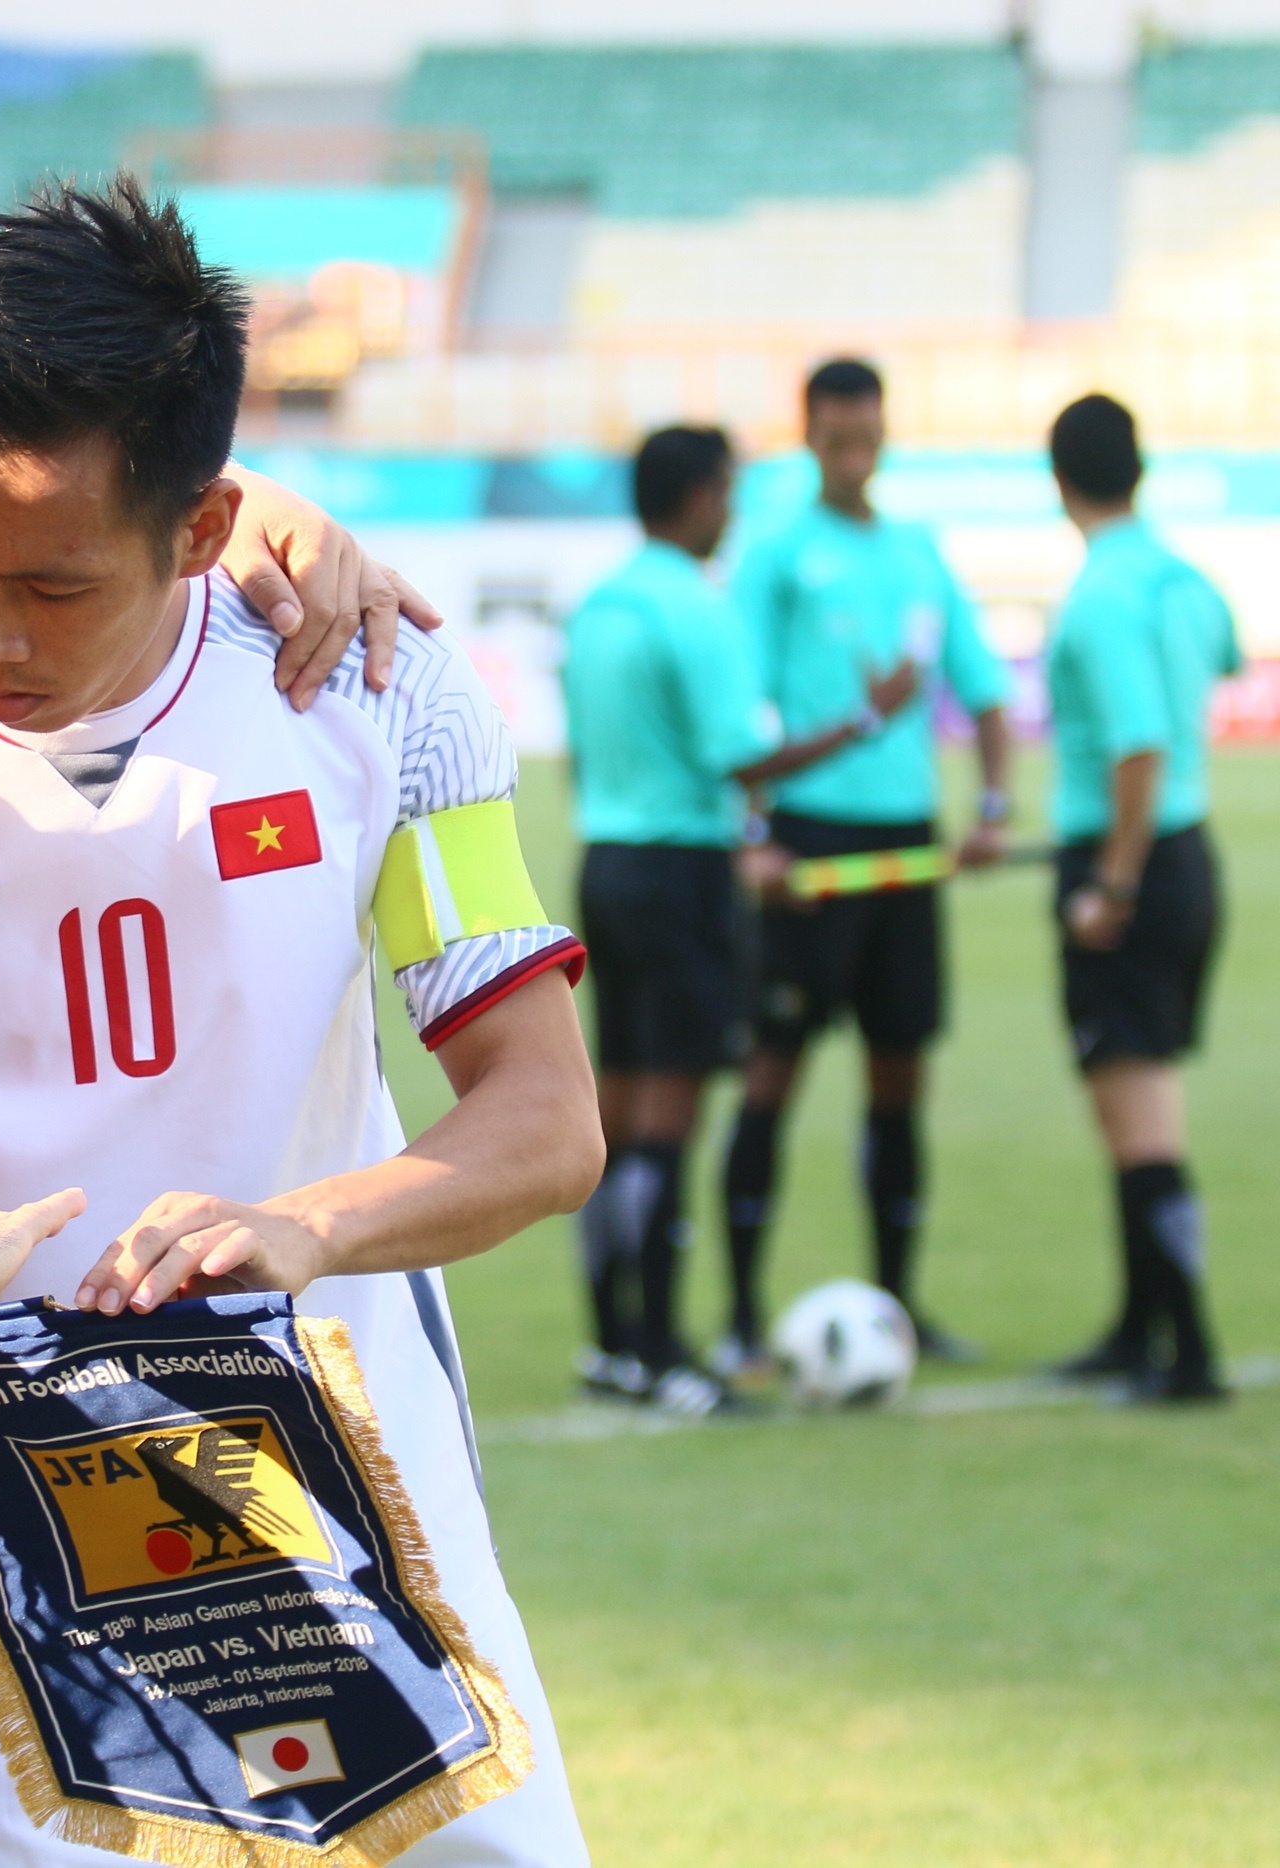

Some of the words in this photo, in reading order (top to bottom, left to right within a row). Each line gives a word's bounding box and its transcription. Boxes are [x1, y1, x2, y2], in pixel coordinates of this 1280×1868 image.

[58, 897, 177, 1085] 10
[7, 1356, 132, 1401] Football
[136, 1348, 288, 1380] Association
[44, 1448, 144, 1486] JFA
[62, 1629, 101, 1647] The
[144, 1613, 195, 1634] Asian
[195, 1601, 262, 1623] Games
[117, 1645, 206, 1678] Japan
[210, 1637, 256, 1660] vs.
[256, 1622, 376, 1652] Vietnam
[169, 1674, 222, 1696] August
[233, 1669, 253, 1684] 01
[253, 1661, 332, 1682] September
[334, 1656, 369, 1673] 2018
[203, 1692, 265, 1714] Jakarta,
[264, 1683, 335, 1704] Indonesia
